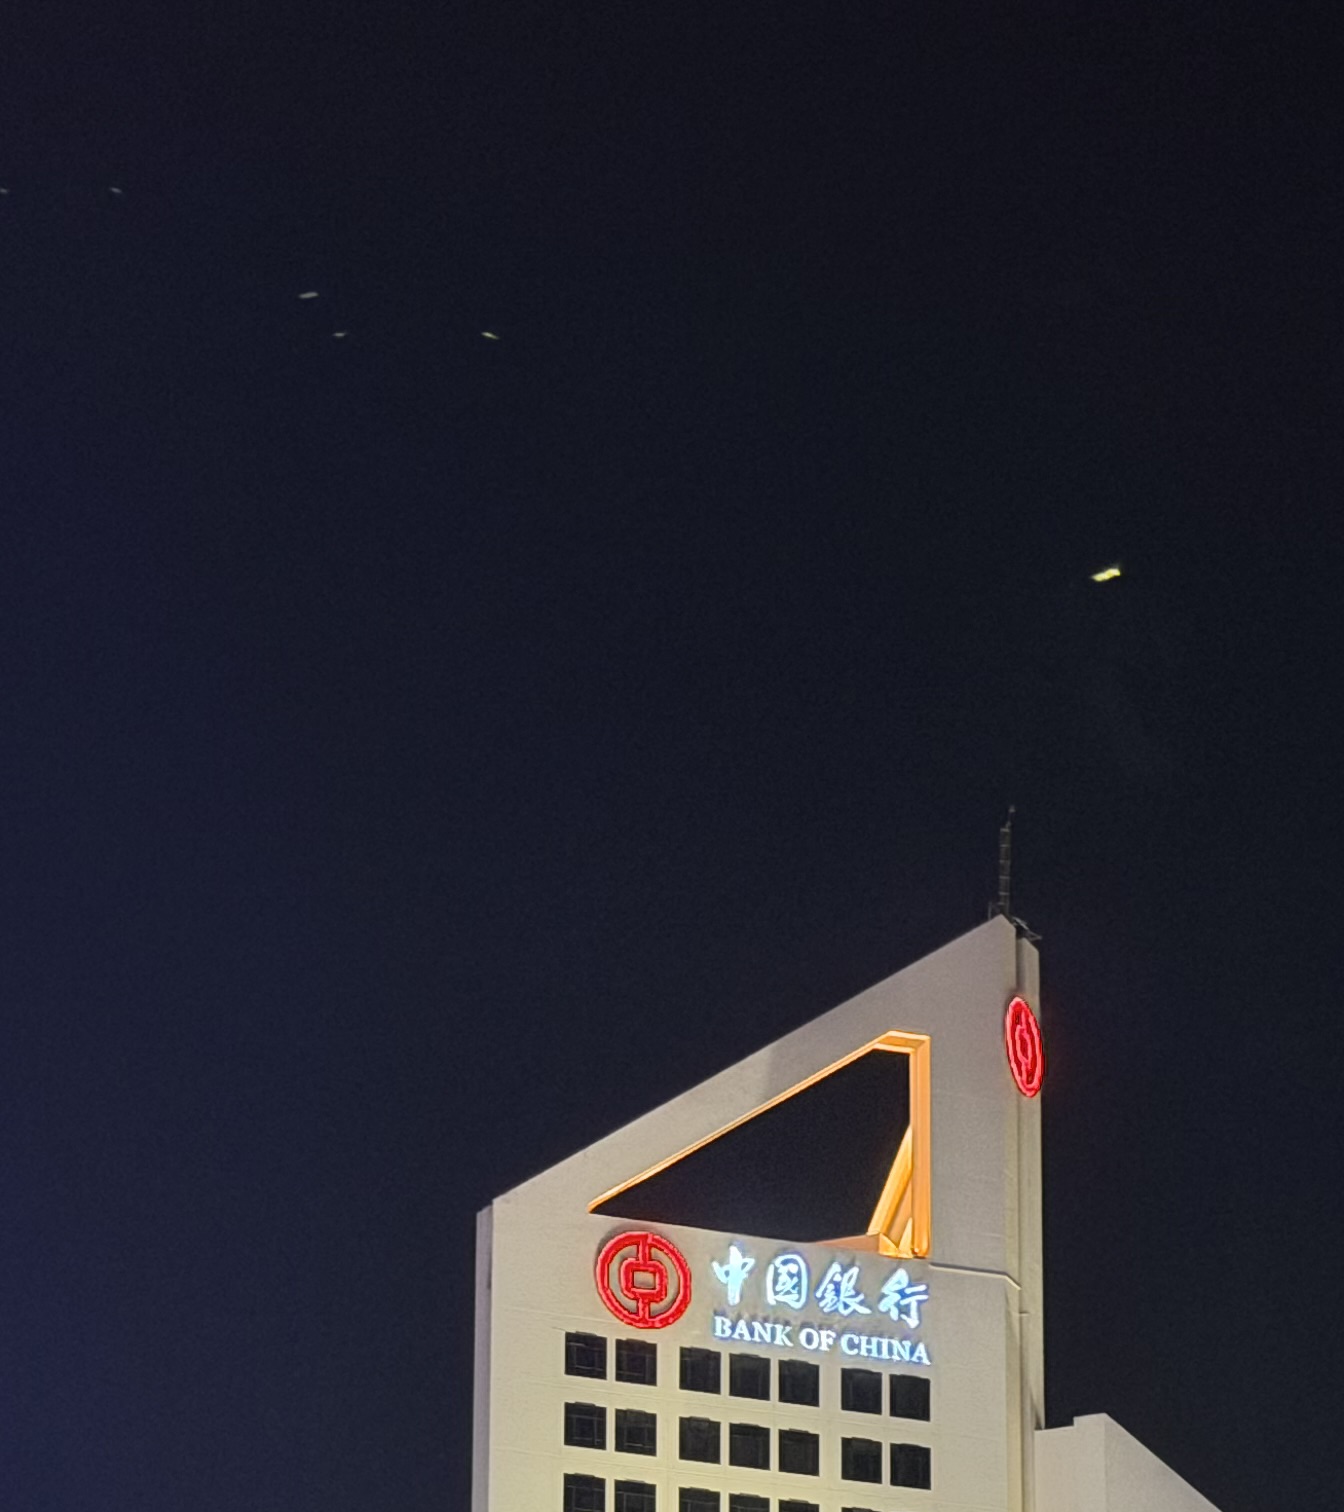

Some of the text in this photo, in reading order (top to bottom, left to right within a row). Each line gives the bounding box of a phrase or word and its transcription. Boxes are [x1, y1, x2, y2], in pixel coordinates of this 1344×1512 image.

[713, 1315, 931, 1365] BANK OF CHINA
